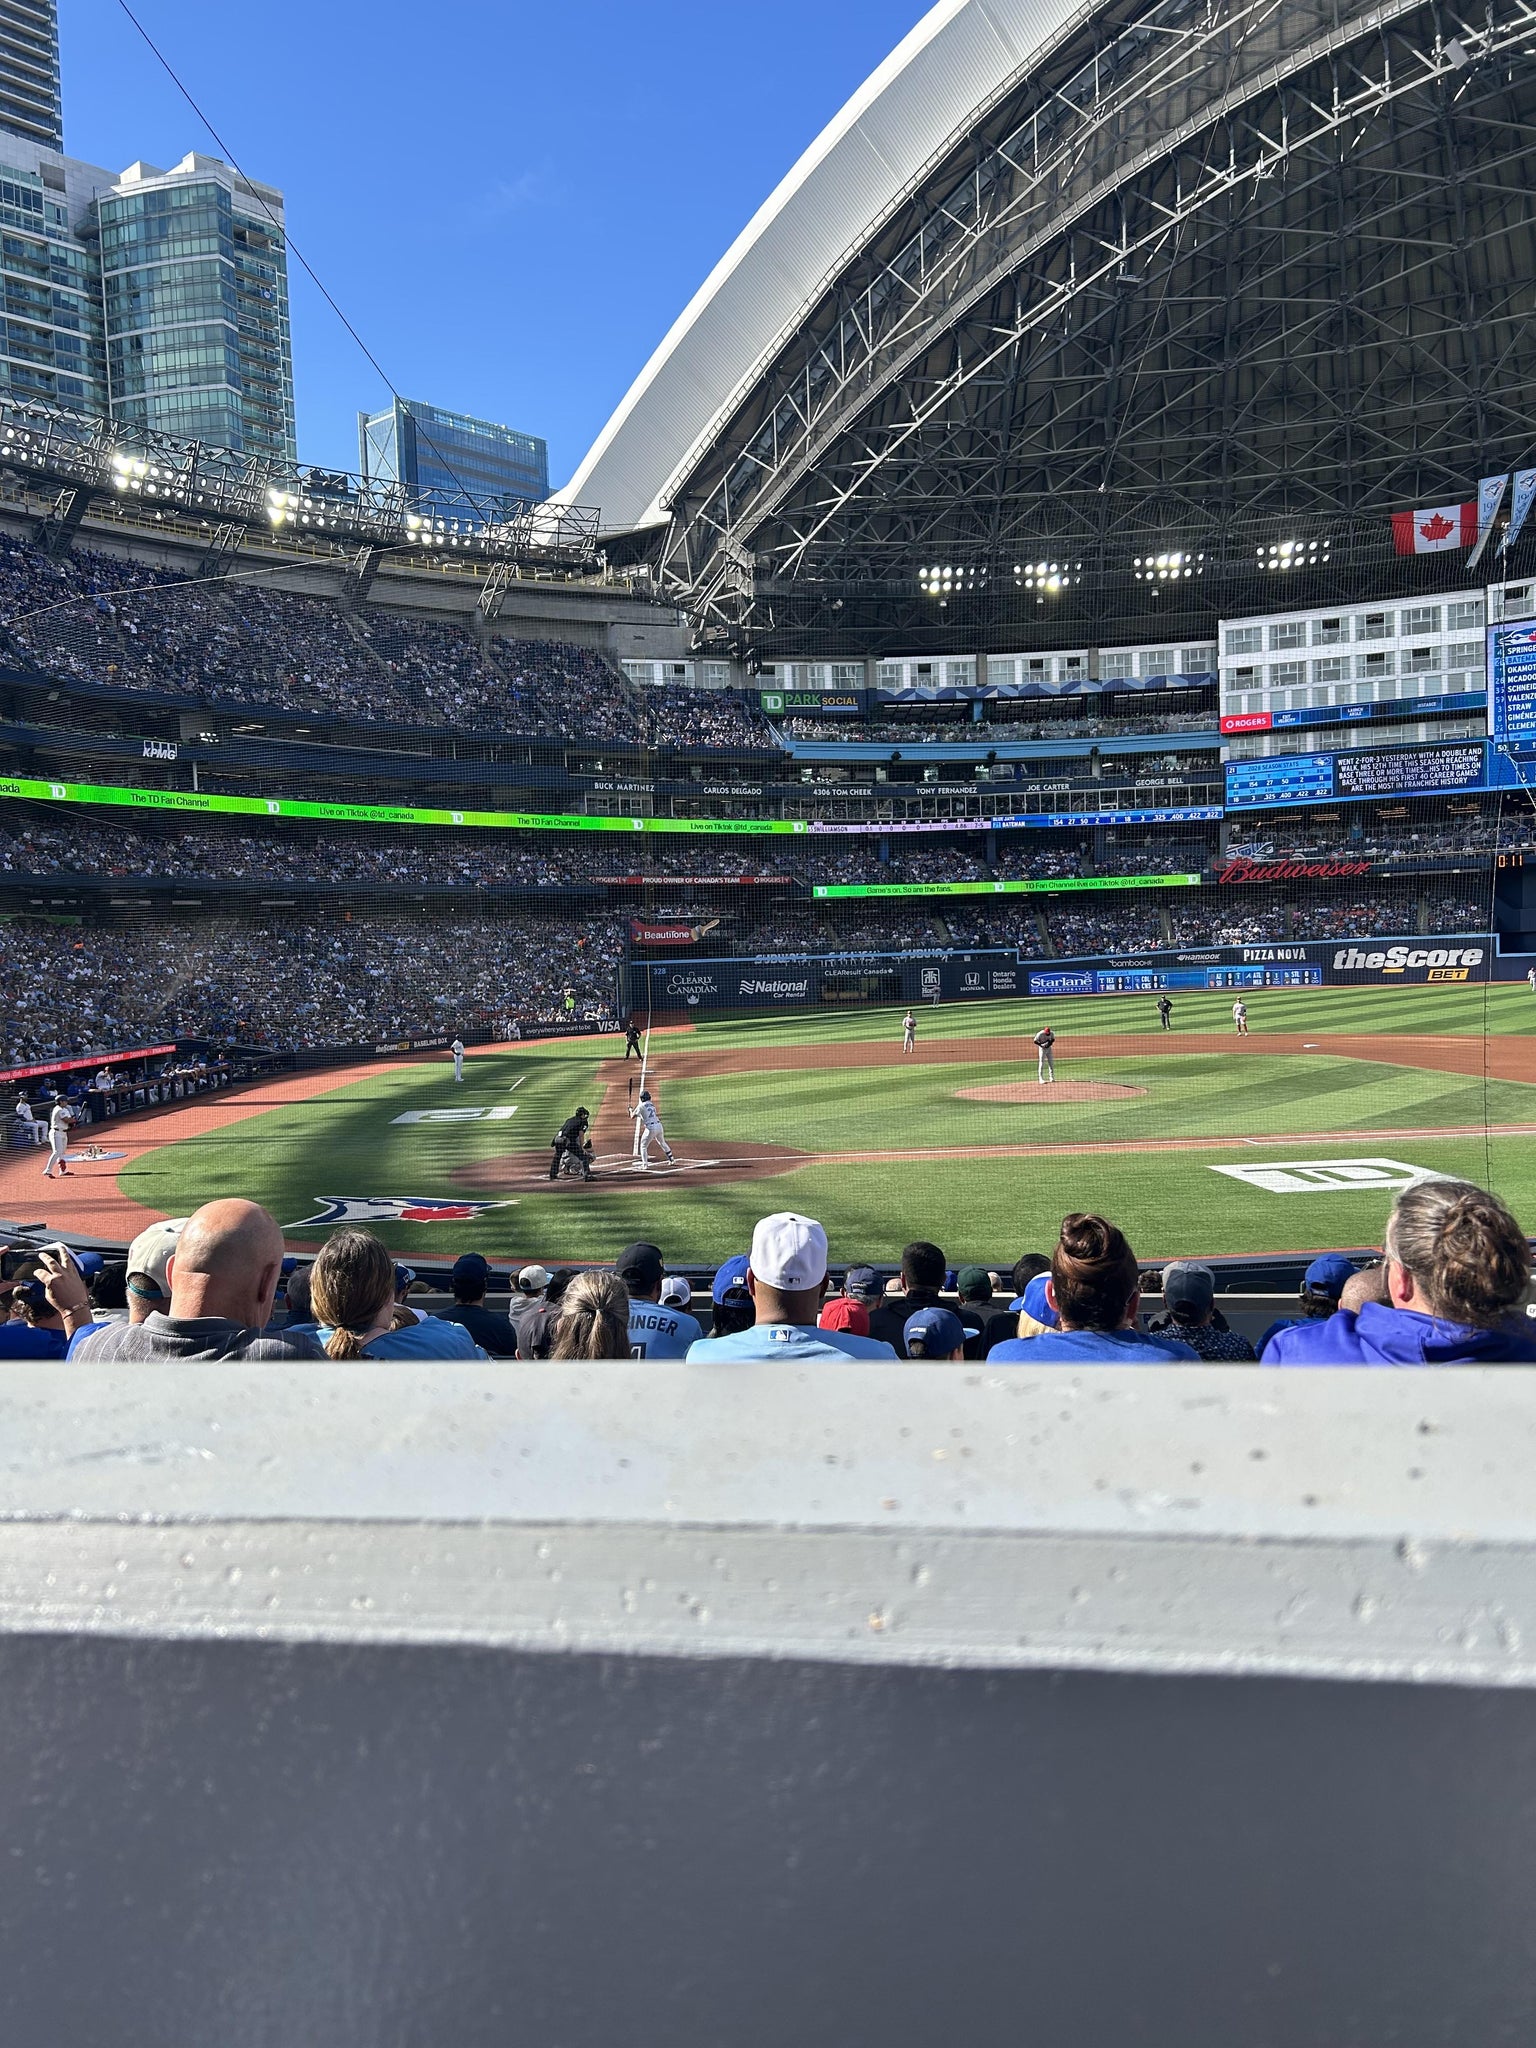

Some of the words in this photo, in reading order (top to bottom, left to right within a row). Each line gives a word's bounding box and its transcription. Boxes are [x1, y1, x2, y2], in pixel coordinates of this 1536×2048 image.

[1508, 645, 1536, 654] SPRINGE
[1508, 664, 1536, 674] OKAMOT
[763, 696, 782, 709] TD
[786, 694, 821, 704] PARK
[822, 697, 858, 706] SOCIAL
[1508, 703, 1532, 712] STRAW
[1236, 718, 1266, 727] ROGERS
[143, 745, 177, 760] KPMG
[1356, 756, 1380, 764] 2-FOR-3
[1382, 754, 1416, 762] YESTERDAY
[1442, 749, 1466, 757] DOUBLE
[1446, 755, 1478, 764] REACHING
[1456, 769, 1478, 777] GAMES
[594, 782, 614, 790] BUCK
[617, 784, 654, 792] MARTINEZ
[1136, 779, 1164, 787] GEORGE
[1404, 779, 1440, 788] FRANCHISE
[1441, 777, 1468, 785] HISTORY
[49, 784, 66, 798] TD
[704, 787, 730, 795] CARLOS
[732, 788, 762, 796] DELGADO
[916, 788, 935, 796] TONY
[938, 786, 978, 795] FERNANDEZ
[1044, 784, 1070, 792] CARTER
[131, 794, 146, 803] The
[148, 795, 160, 804] TD
[161, 796, 176, 805] Fan
[176, 796, 210, 808] Channel
[266, 801, 280, 814] TD
[320, 807, 334, 816] Live
[346, 808, 368, 818] Tiktok
[370, 810, 414, 820] @td_canada
[451, 812, 464, 824] TD
[517, 817, 530, 826] The
[554, 818, 580, 827] Channel
[632, 820, 644, 830] TD
[791, 822, 804, 832] TD
[734, 824, 772, 832] @td_canada
[1498, 855, 1523, 868] 0:11
[1212, 857, 1372, 884] Budweiser
[994, 882, 1004, 892] TD
[1099, 879, 1119, 887] Tiktok
[1121, 878, 1164, 886] @td_canada
[818, 886, 828, 896] TD
[644, 930, 690, 940] BeautiTone
[1244, 948, 1274, 961] PIZZA
[1278, 948, 1306, 960] NOVA
[1333, 946, 1483, 970] theScore
[654, 967, 666, 975] 328
[1432, 970, 1466, 980] BET
[672, 975, 712, 986] CLEARLY
[1030, 975, 1092, 988] Starlane
[667, 984, 718, 995] CANADIAN
[755, 980, 808, 992] National
[597, 1020, 620, 1032] VISA
[414, 1039, 437, 1048] BASELINE
[438, 1037, 448, 1046] BOX
[376, 1044, 398, 1053] theScore
[630, 1315, 678, 1336] INGER
